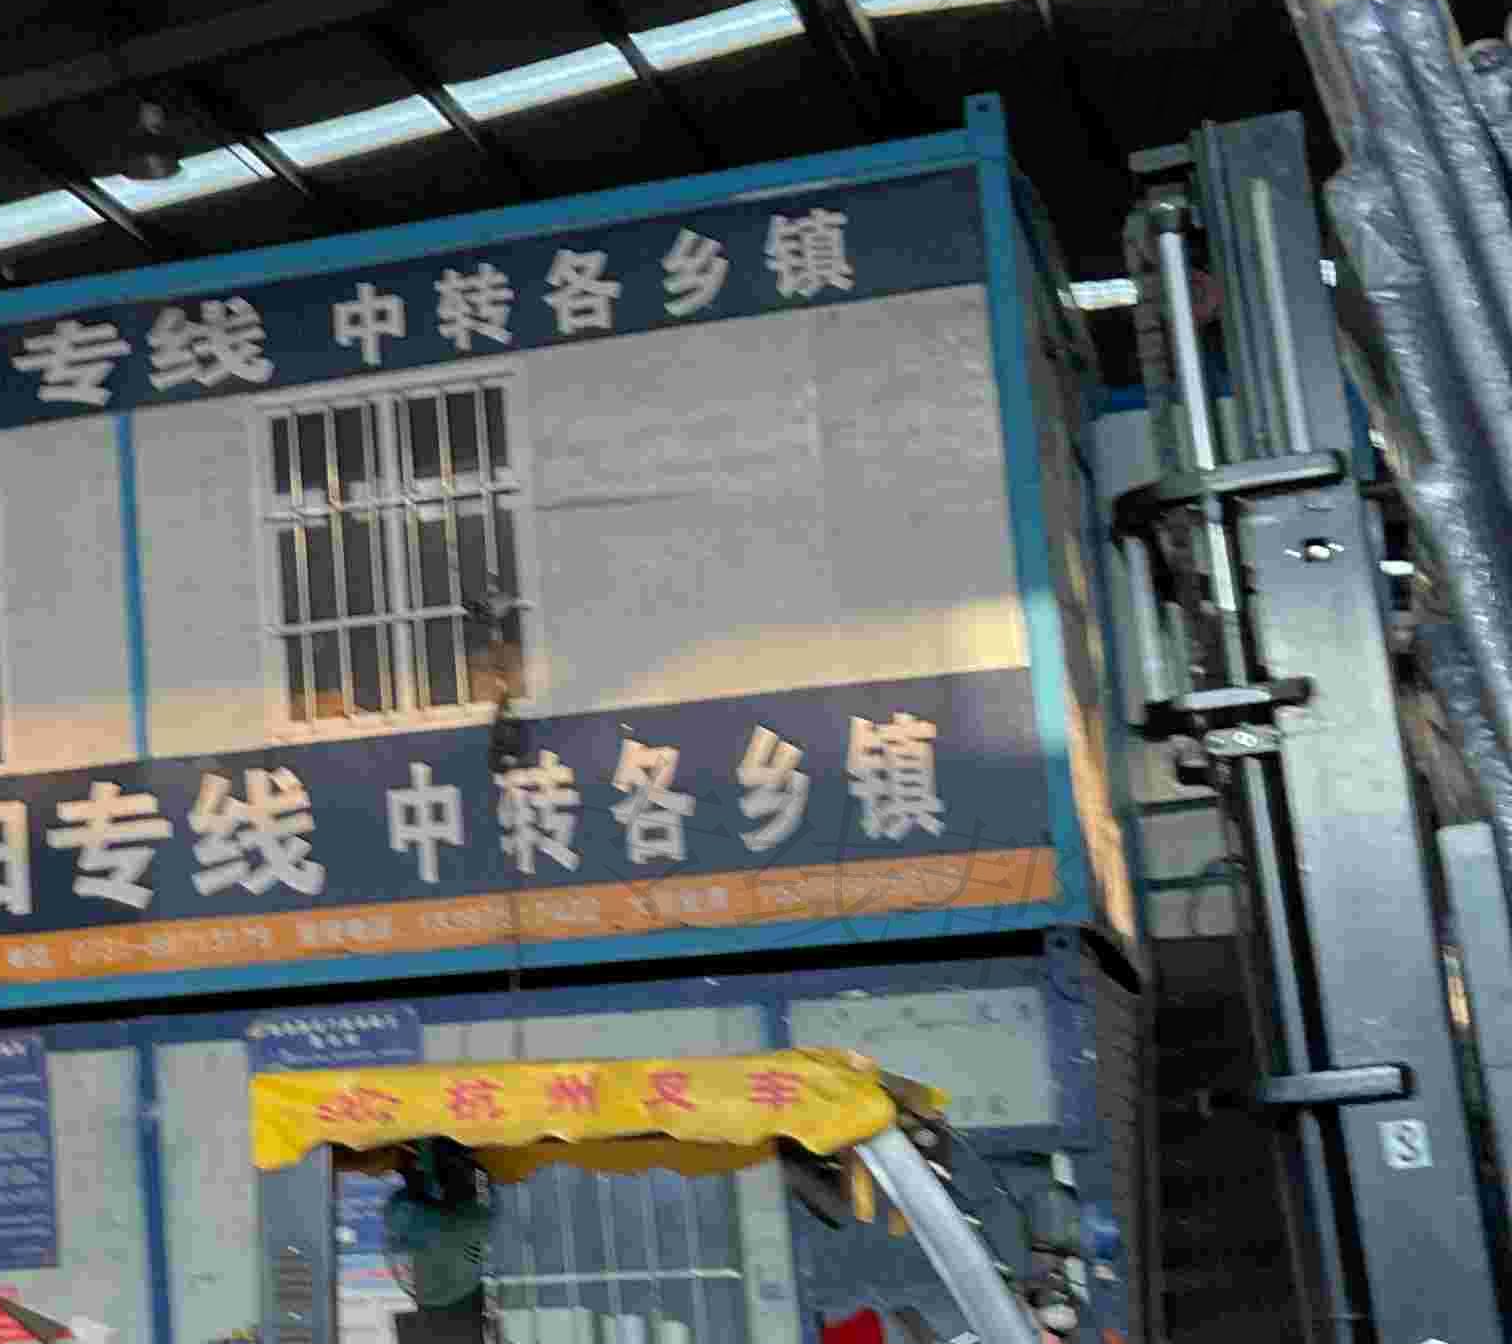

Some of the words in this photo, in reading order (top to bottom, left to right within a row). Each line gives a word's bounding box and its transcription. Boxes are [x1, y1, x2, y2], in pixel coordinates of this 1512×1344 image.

[333, 208, 855, 367] 中转各乡镇
[388, 713, 945, 883] 中转各乡镇
